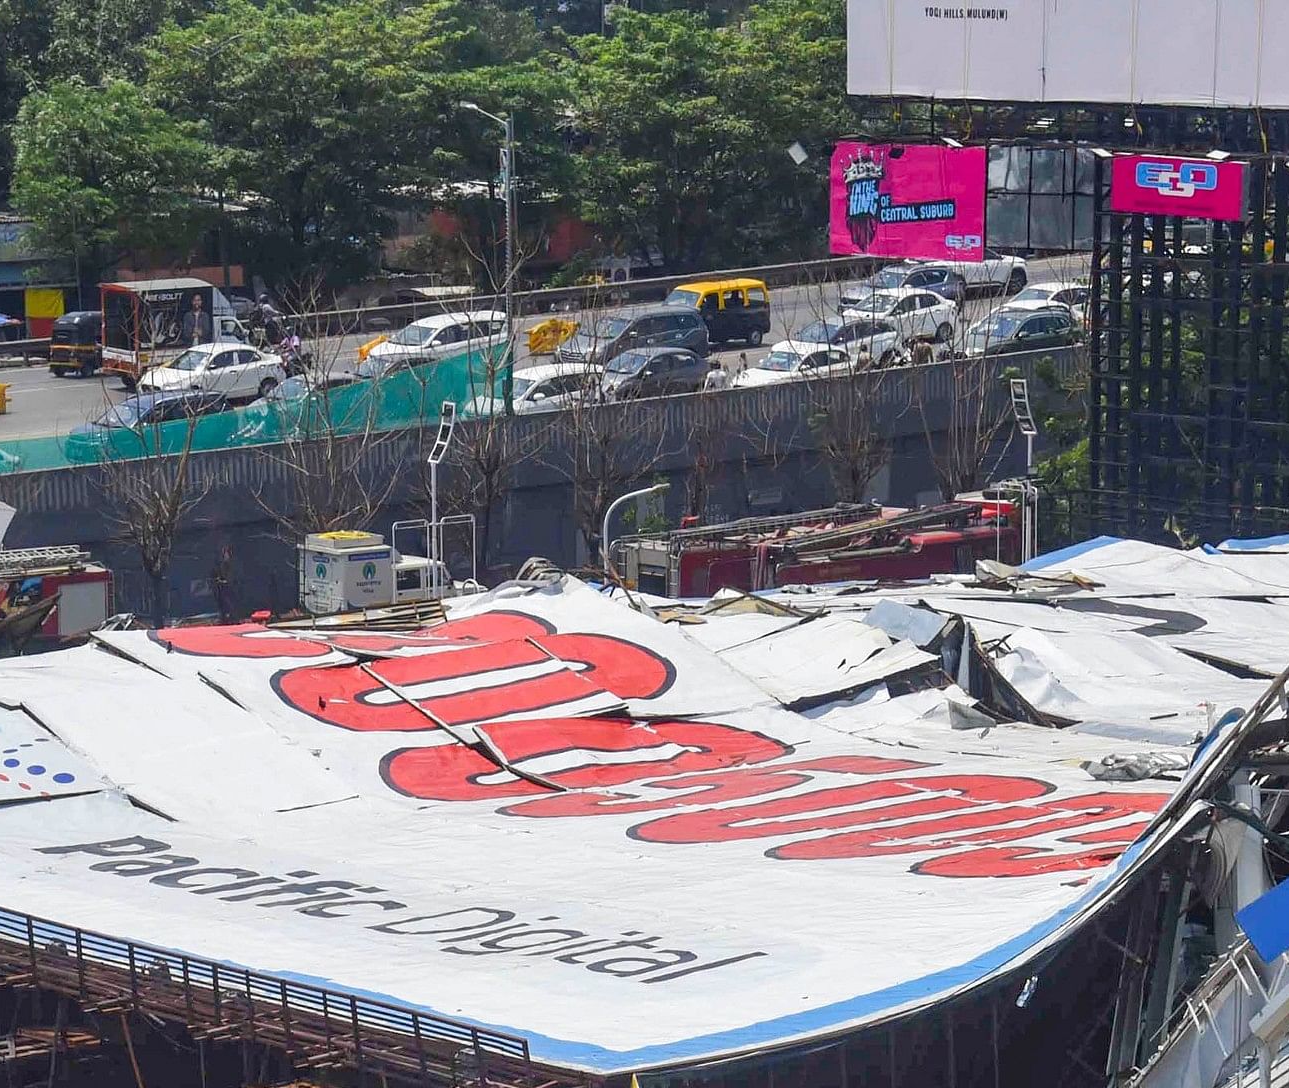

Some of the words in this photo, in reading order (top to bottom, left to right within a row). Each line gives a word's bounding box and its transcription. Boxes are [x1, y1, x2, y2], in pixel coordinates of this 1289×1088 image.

[924, 7, 942, 18] YOGI
[967, 8, 1008, 21] MULUND(W)
[849, 191, 879, 217] KING
[880, 195, 891, 207] OF
[880, 206, 919, 223] CENTRAL
[919, 203, 954, 220] SUBURB
[32, 834, 408, 919] Pacific
[366, 907, 769, 985] Digital
